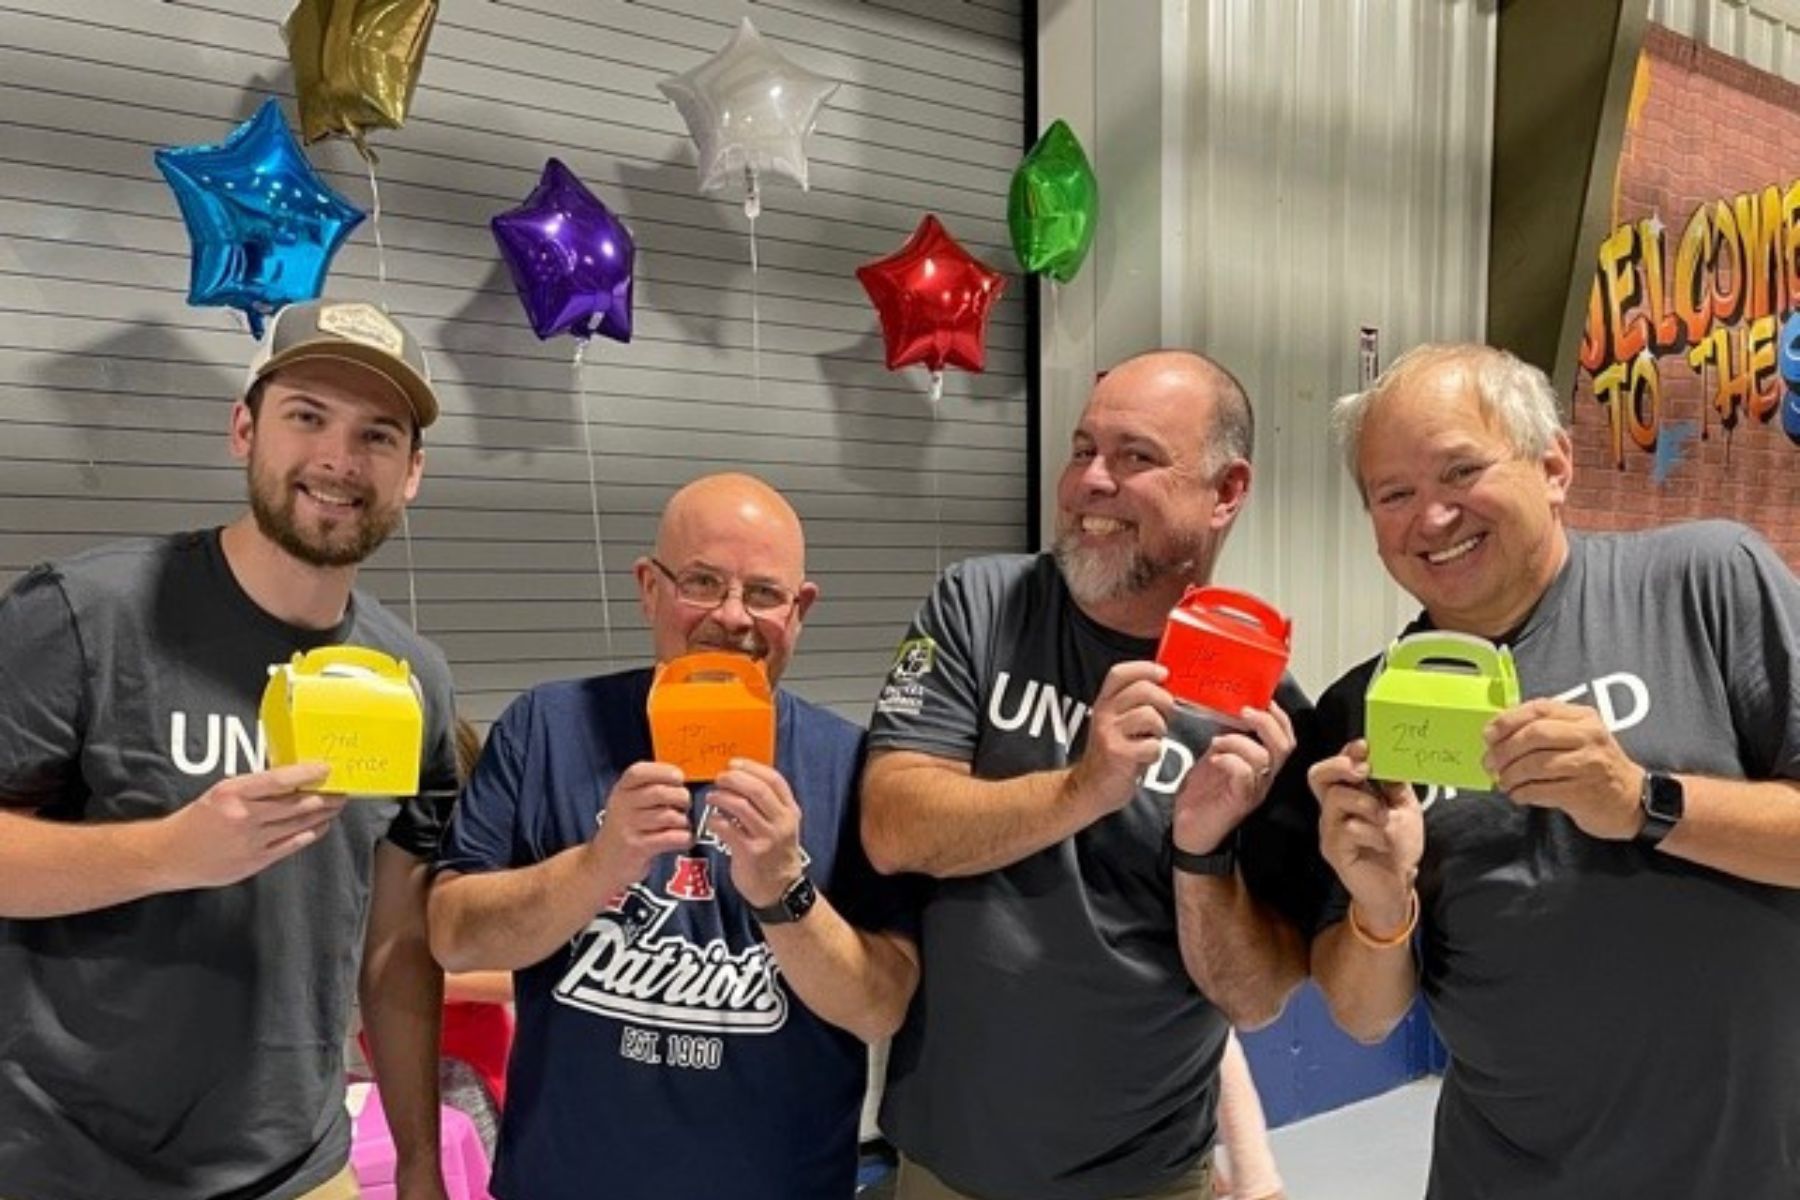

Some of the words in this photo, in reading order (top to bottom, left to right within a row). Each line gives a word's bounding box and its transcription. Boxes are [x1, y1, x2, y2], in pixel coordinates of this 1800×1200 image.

[1594, 355, 1660, 462] TO
[1689, 315, 1782, 425] THE
[666, 1034, 724, 1070] 1960
